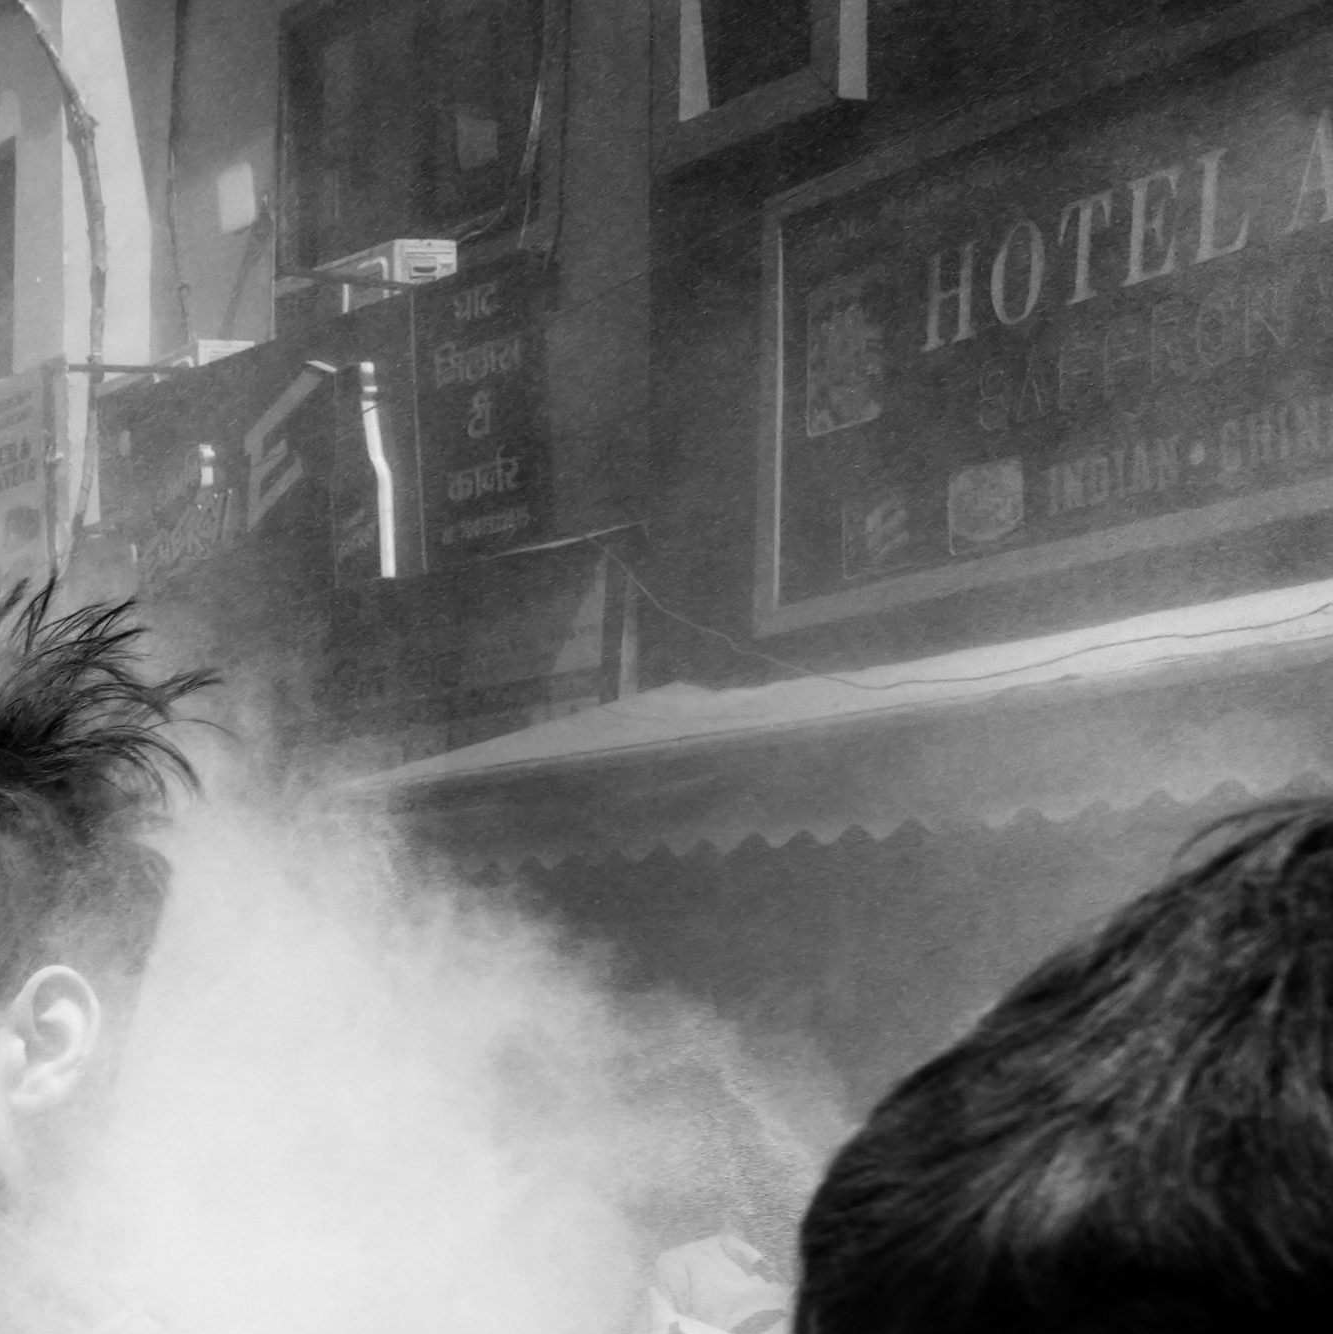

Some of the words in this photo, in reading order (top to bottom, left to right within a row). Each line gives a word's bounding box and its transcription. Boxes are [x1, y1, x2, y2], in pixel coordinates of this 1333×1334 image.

[920, 147, 1250, 353] HOTEL
[1047, 435, 1179, 516] INDIAN
[1219, 393, 1333, 475] CHIN
